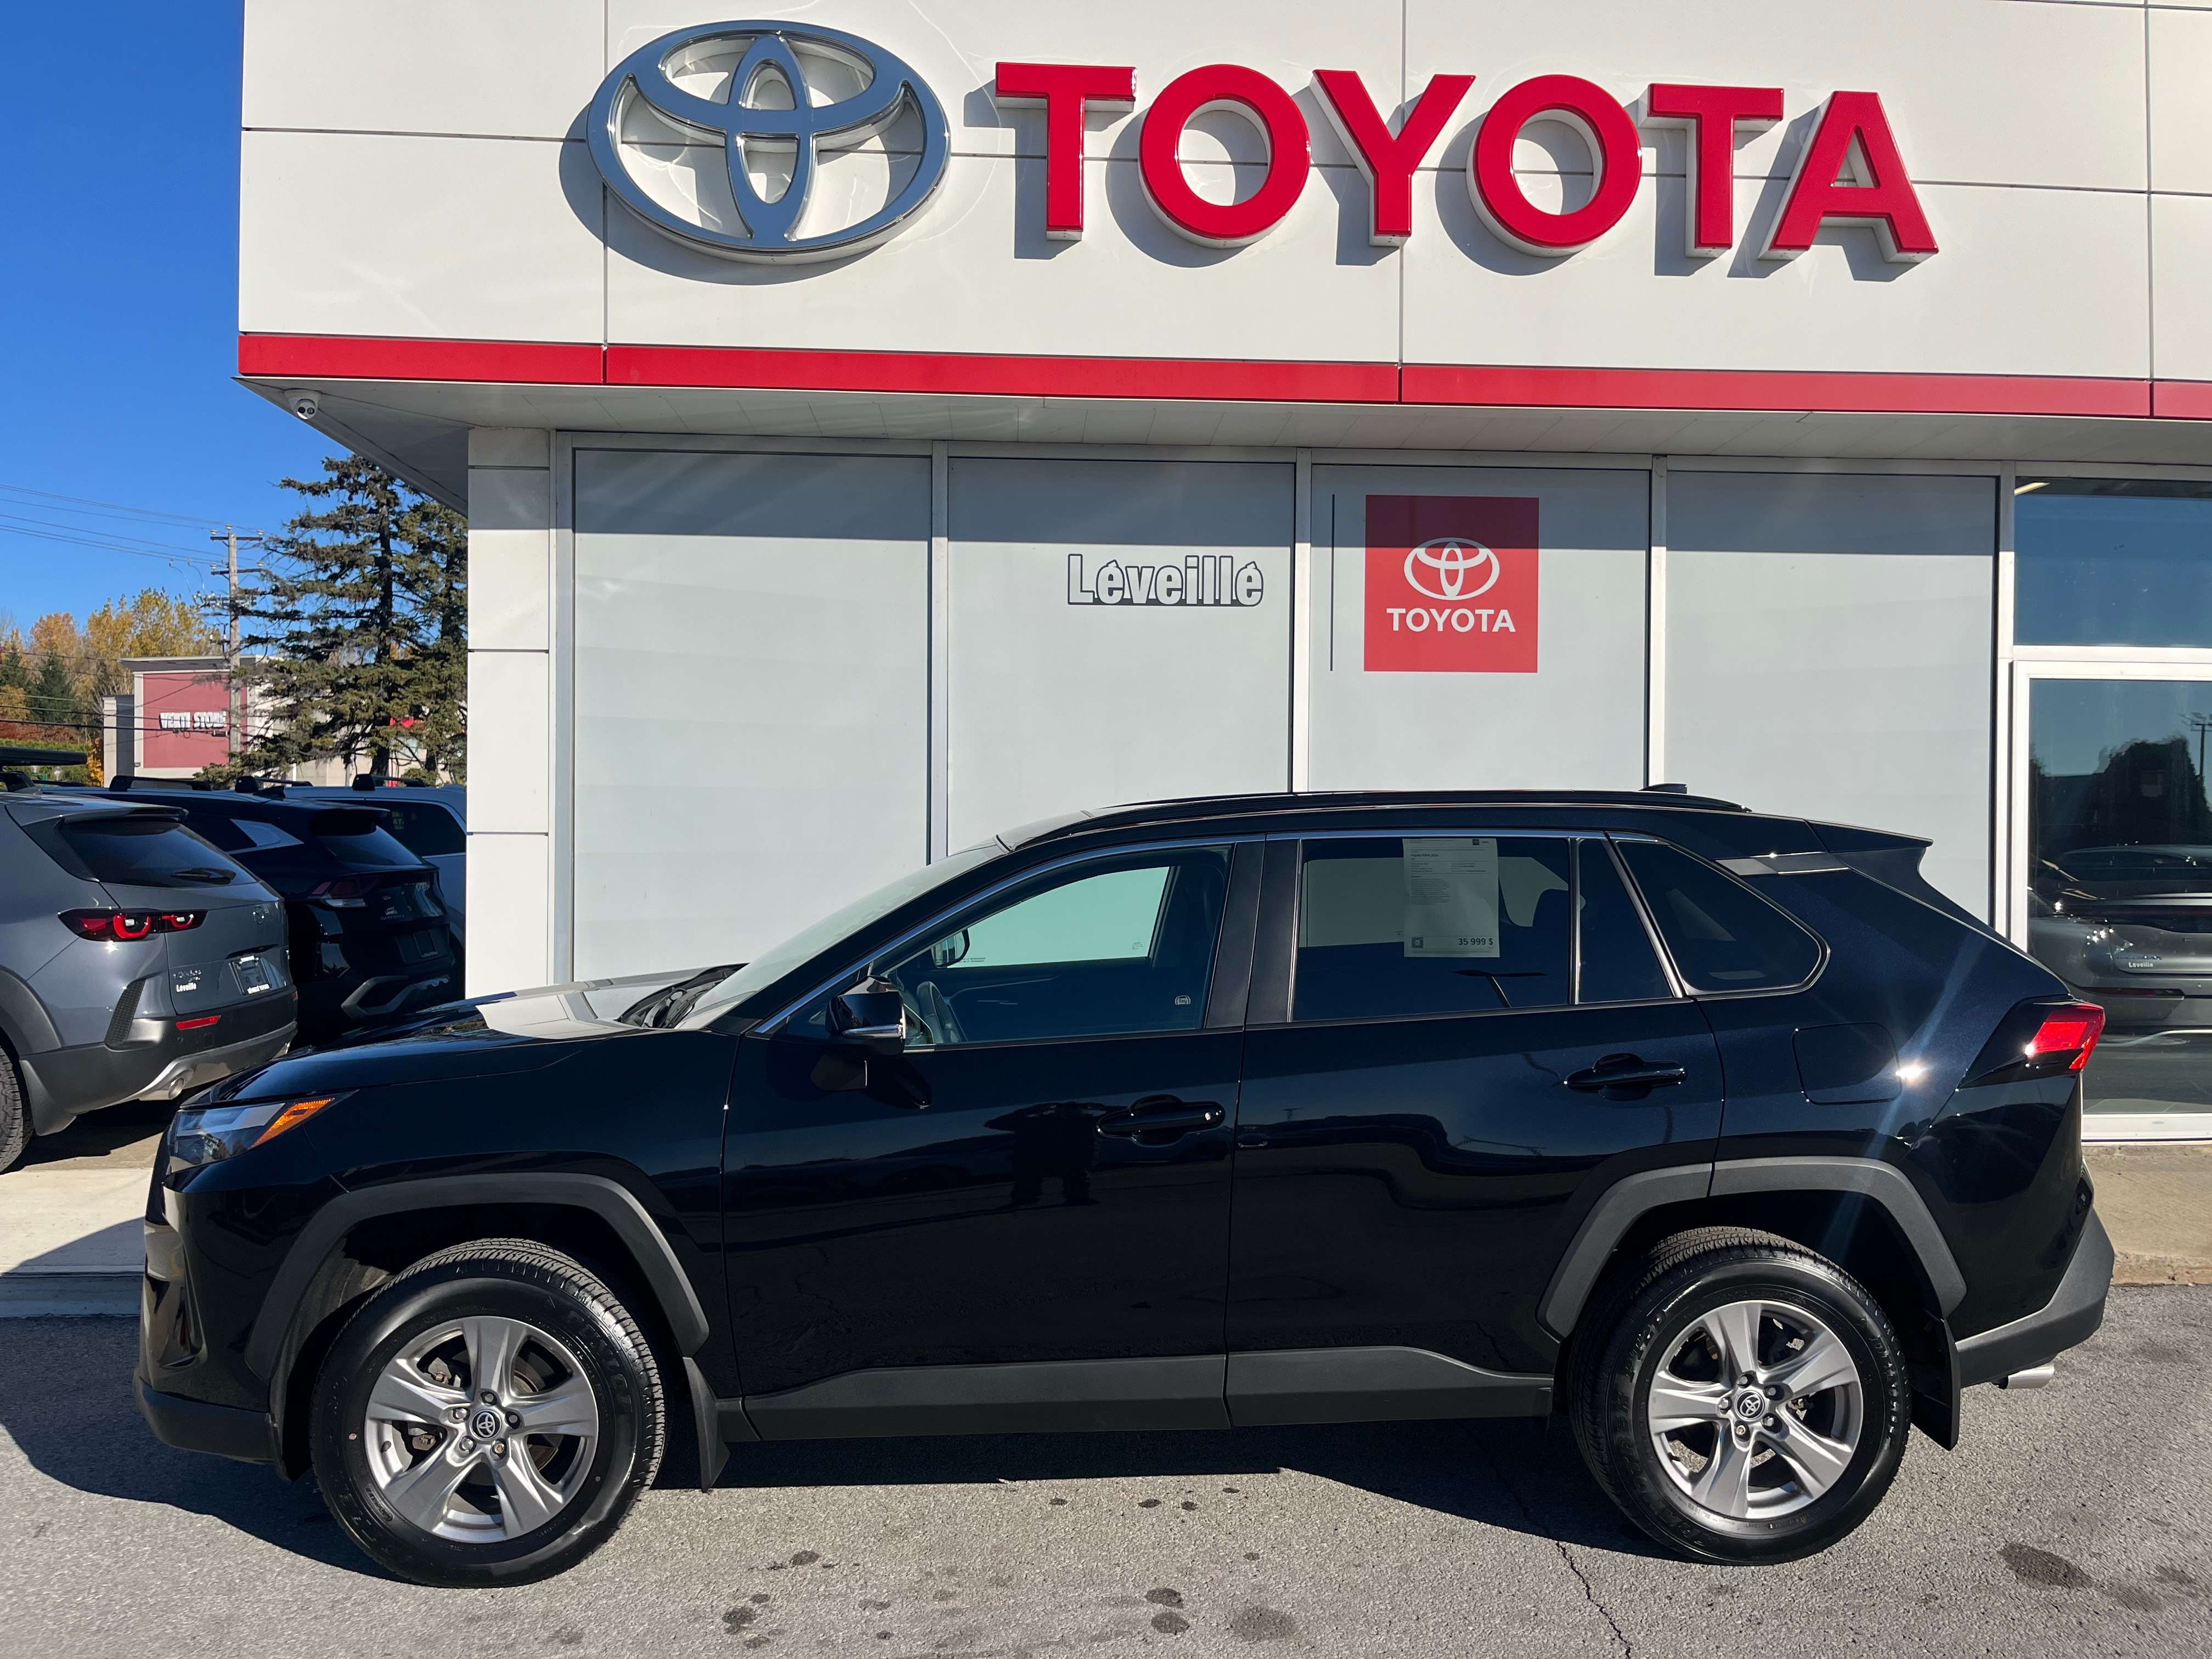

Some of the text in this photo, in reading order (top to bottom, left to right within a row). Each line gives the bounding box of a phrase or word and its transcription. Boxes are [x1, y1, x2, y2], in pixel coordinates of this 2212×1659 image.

[995, 61, 1938, 261] TOYOTA
[1067, 553, 1264, 607] Léveillé
[1386, 607, 1516, 633] TOYOTA
[1488, 937, 1493, 945] $
